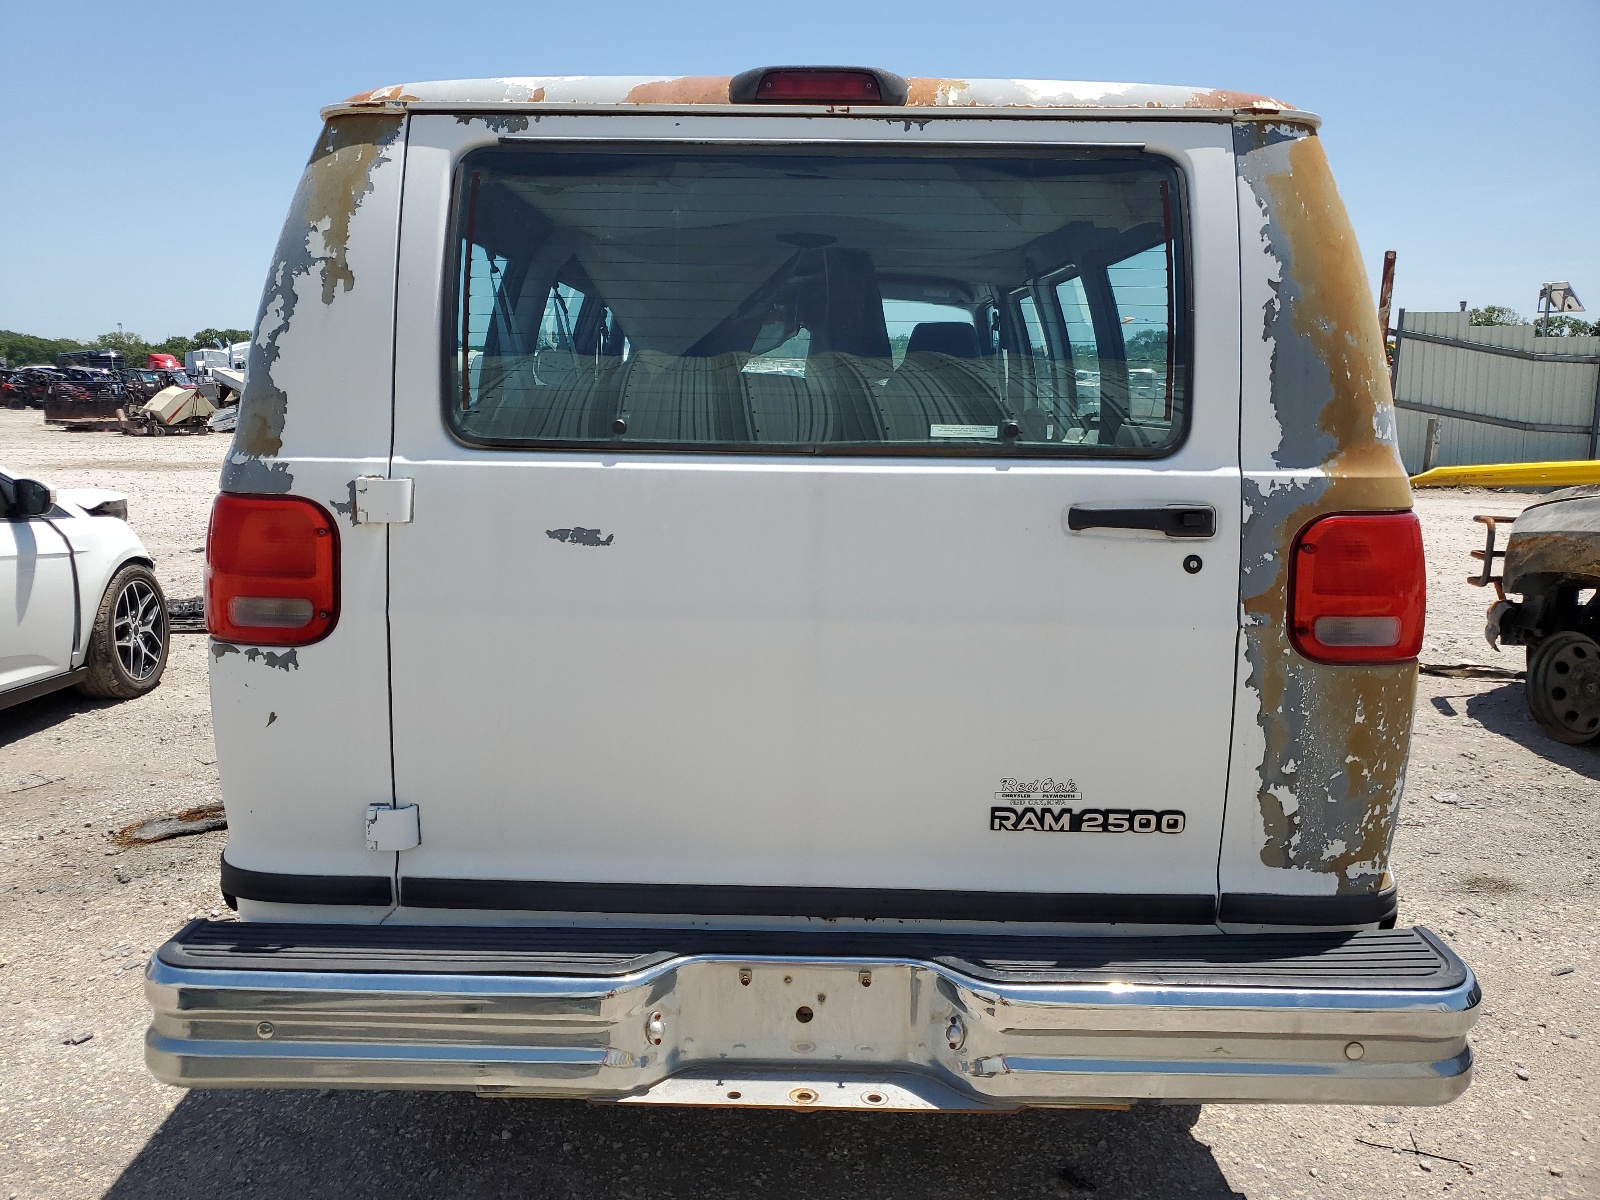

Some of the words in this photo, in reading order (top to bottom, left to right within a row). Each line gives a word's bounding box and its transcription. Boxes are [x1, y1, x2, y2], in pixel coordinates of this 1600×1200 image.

[1000, 778, 1039, 792] Red
[1040, 778, 1078, 793] Oak
[991, 807, 1072, 831] RAM
[1080, 809, 1186, 834] 2500
